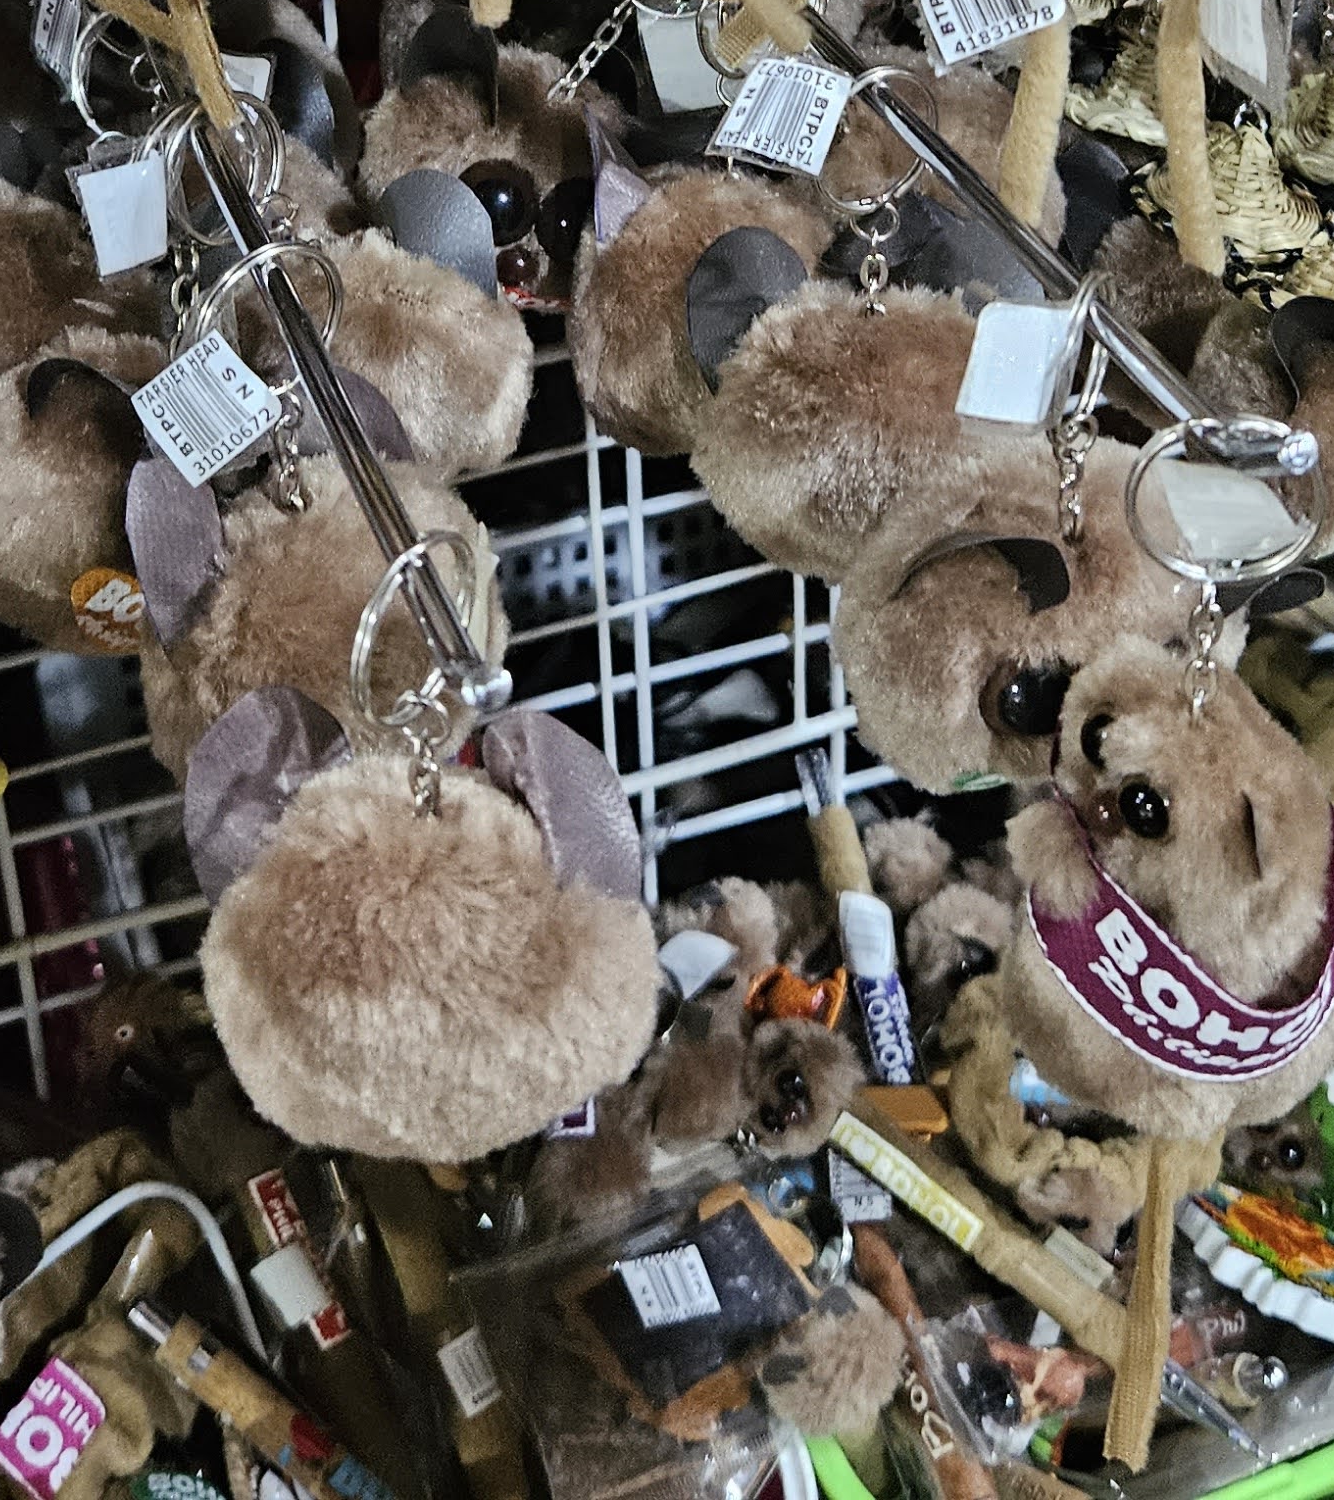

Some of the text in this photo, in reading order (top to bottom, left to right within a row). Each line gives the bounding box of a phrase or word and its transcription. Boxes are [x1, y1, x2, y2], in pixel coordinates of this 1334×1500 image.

[954, 5, 1055, 55] 41831878
[756, 63, 838, 92] 31010672
[798, 96, 831, 150] BTPC
[752, 134, 813, 167] TARSIER
[138, 336, 221, 410] TARSIER HEAD
[221, 367, 255, 401] N S
[151, 403, 195, 458] BTPC
[193, 406, 276, 478] 31010672
[870, 1148, 971, 1245] BOHOL
